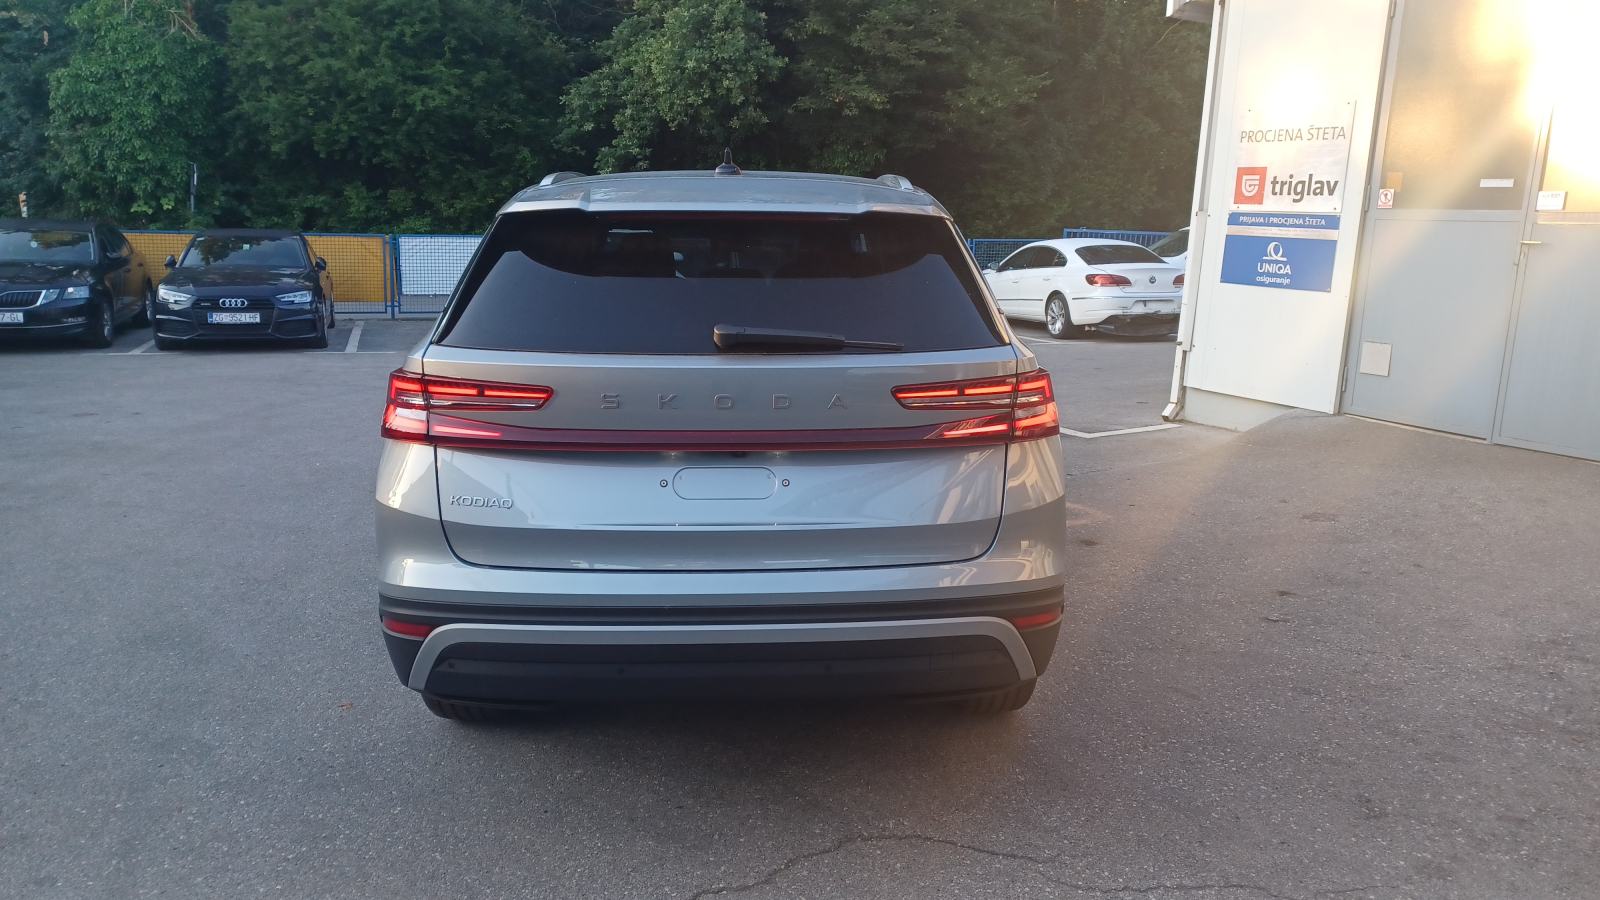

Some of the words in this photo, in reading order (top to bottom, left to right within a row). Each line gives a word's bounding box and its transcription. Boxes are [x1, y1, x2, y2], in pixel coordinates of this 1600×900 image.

[1240, 128, 1303, 143] PROCJENA
[1306, 124, 1346, 141] ŠTETA
[1270, 173, 1339, 203] triglav
[1239, 216, 1264, 224] PRIJAVA
[1268, 217, 1304, 225] PROCJENA
[1304, 216, 1326, 226] ŠTETA
[1257, 262, 1292, 275] UNIQA
[1256, 275, 1291, 285] osiguranje
[600, 392, 848, 410] SKODA
[449, 495, 514, 510] KODIAQ
